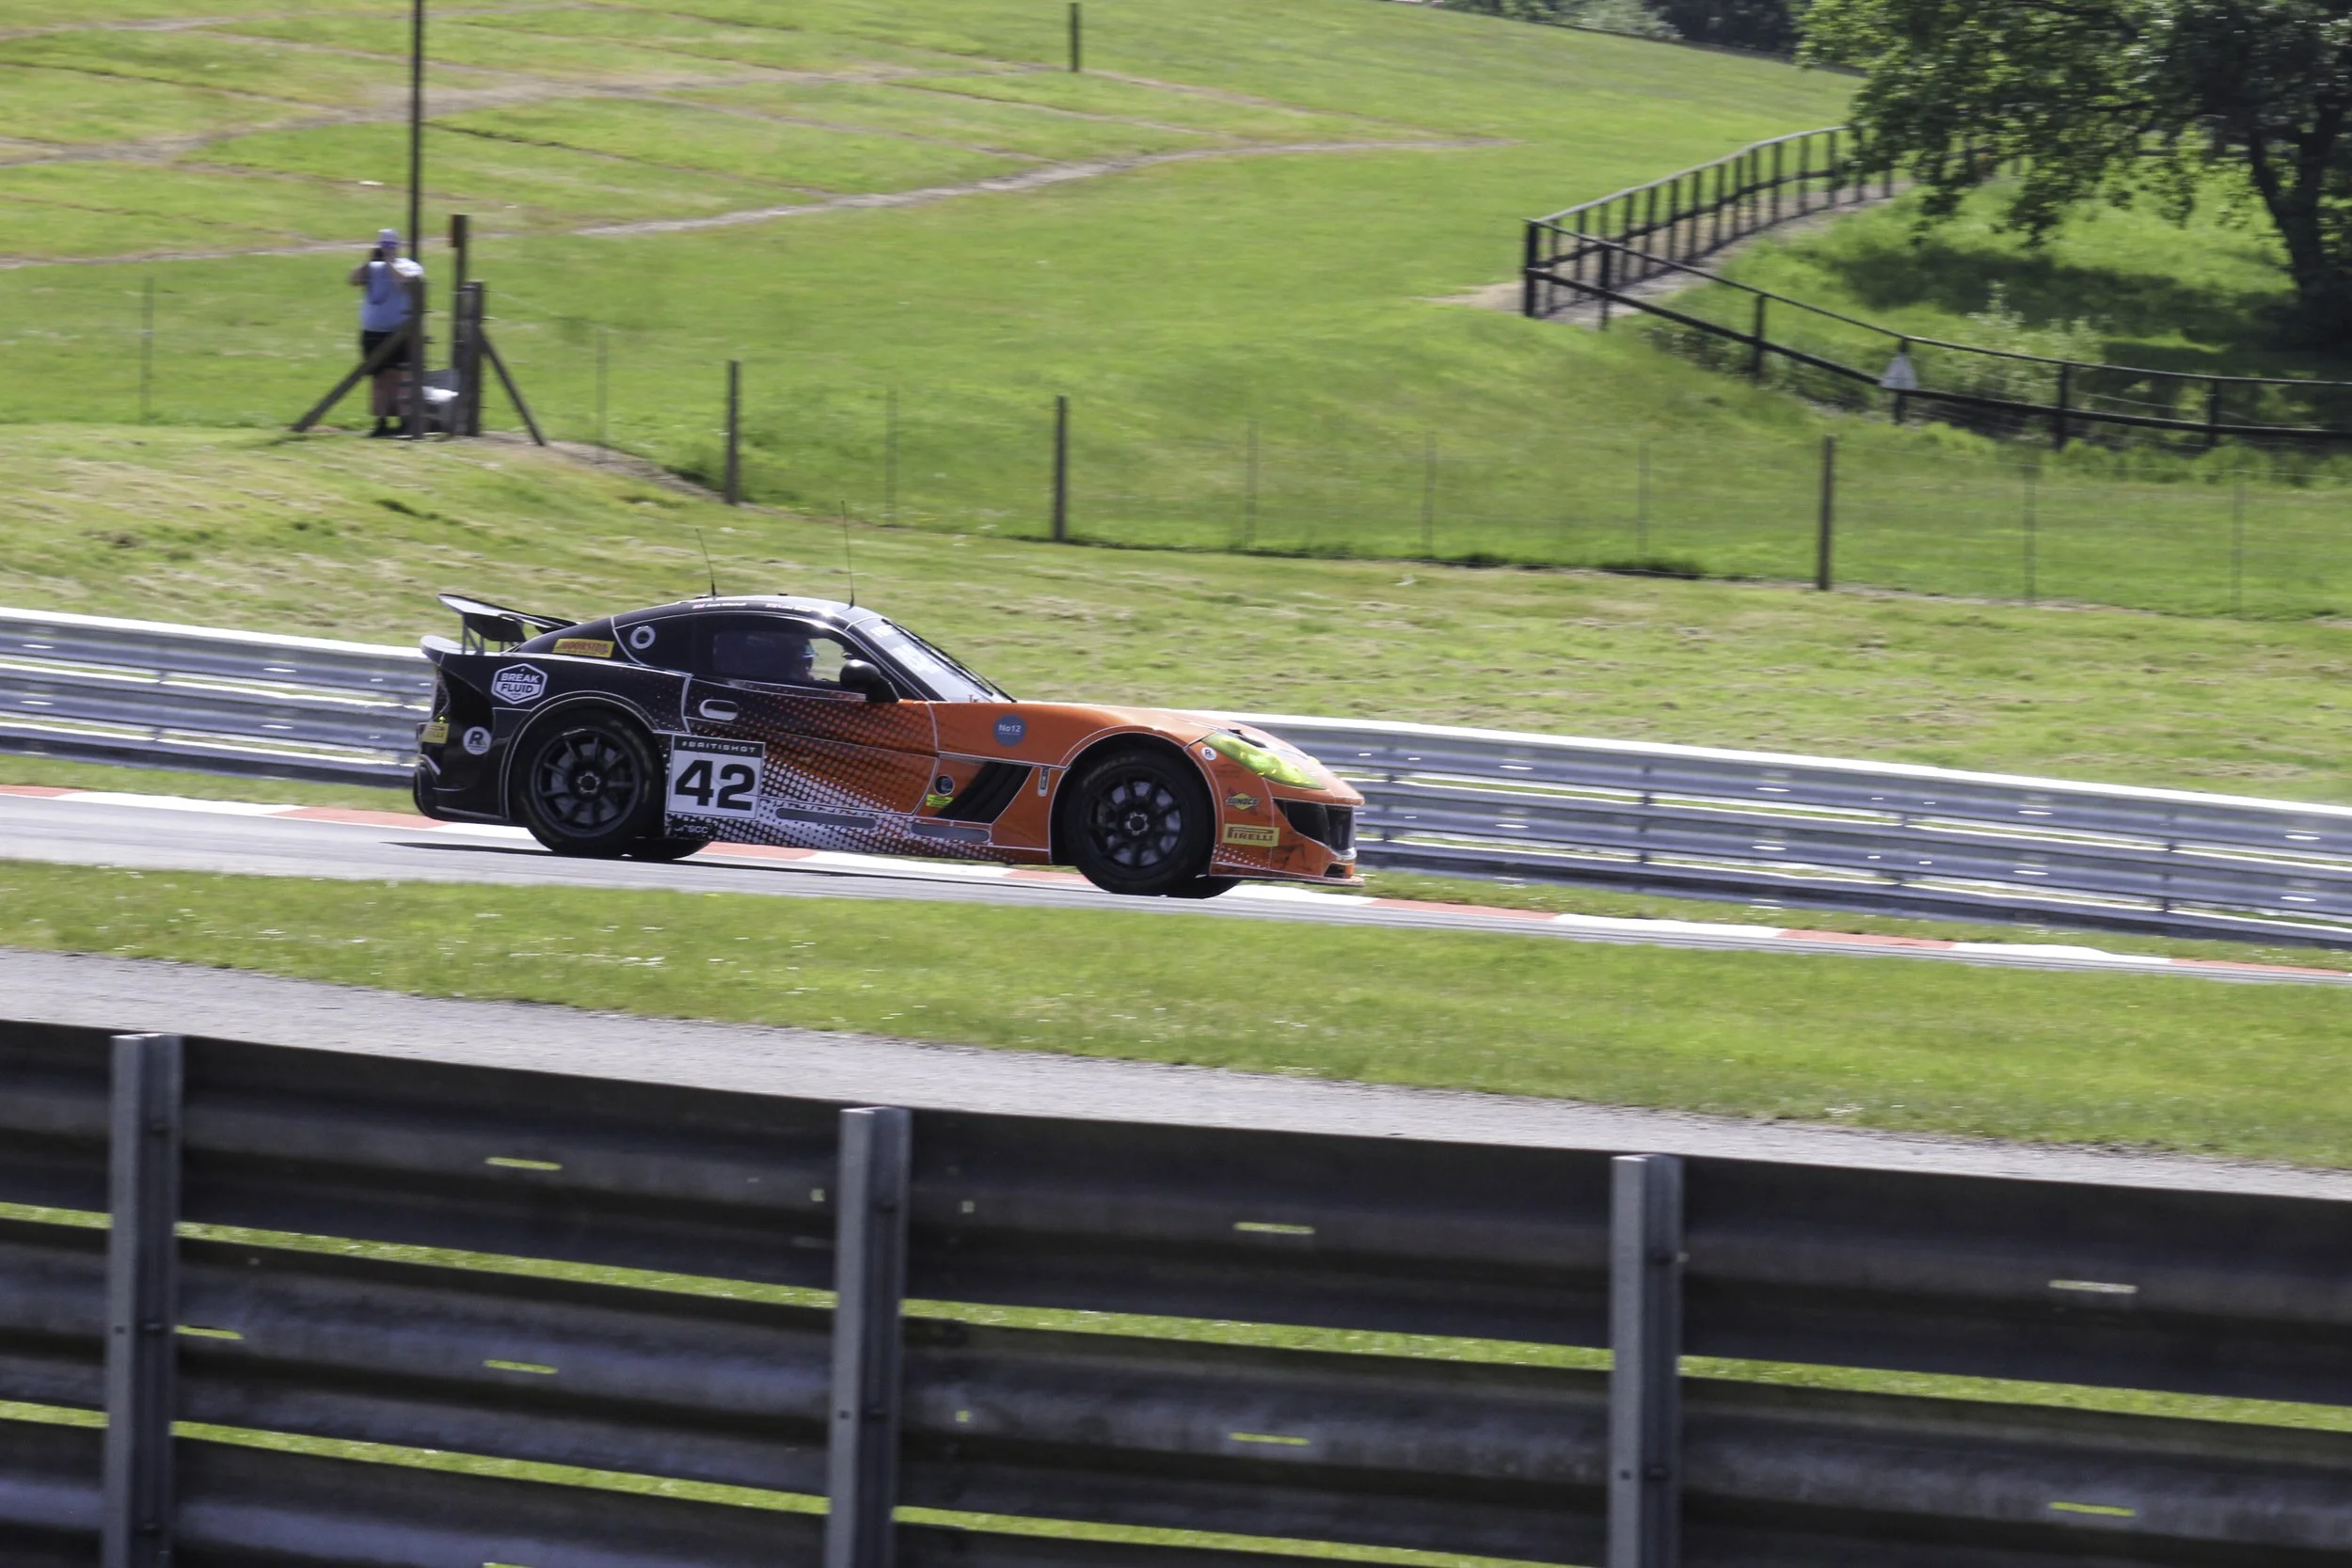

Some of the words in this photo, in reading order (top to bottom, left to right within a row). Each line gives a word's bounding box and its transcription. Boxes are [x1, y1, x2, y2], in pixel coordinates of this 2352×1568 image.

[501, 673, 540, 683] BREAK
[501, 683, 533, 693] FLUID
[675, 759, 755, 811] 42
[1227, 827, 1274, 841] PIRELLI
